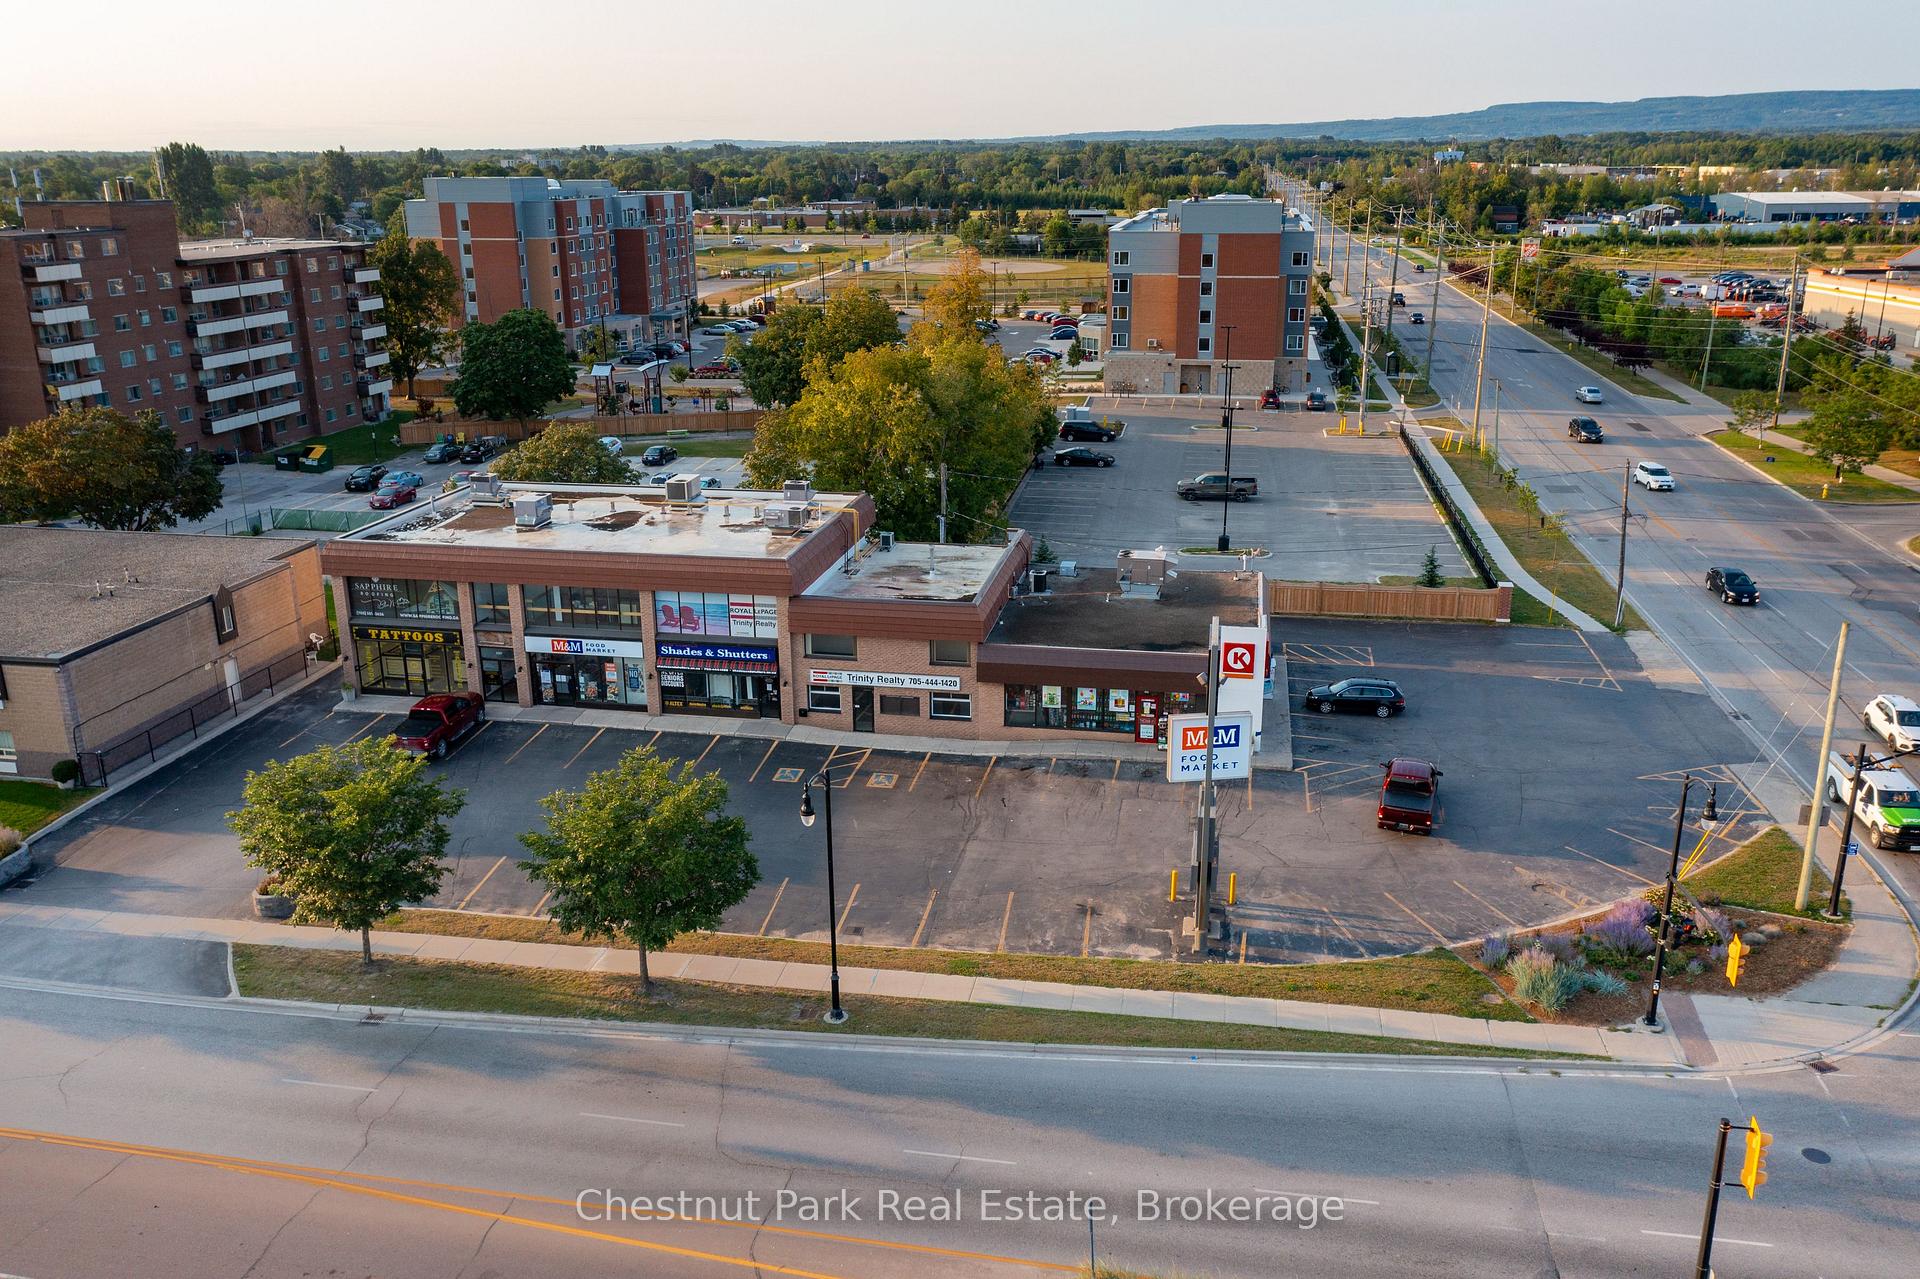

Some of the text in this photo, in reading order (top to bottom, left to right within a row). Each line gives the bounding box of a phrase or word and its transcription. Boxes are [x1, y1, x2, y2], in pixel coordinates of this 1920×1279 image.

[355, 583, 398, 592] SAPPHIRE
[733, 619, 776, 628] Trinity Realty
[368, 629, 444, 643] TATTOOS
[554, 640, 582, 652] M&M
[661, 646, 768, 659] Shades & Shutters
[629, 670, 638, 678] NO
[847, 673, 958, 688] Trinity Realty 705-444-1420
